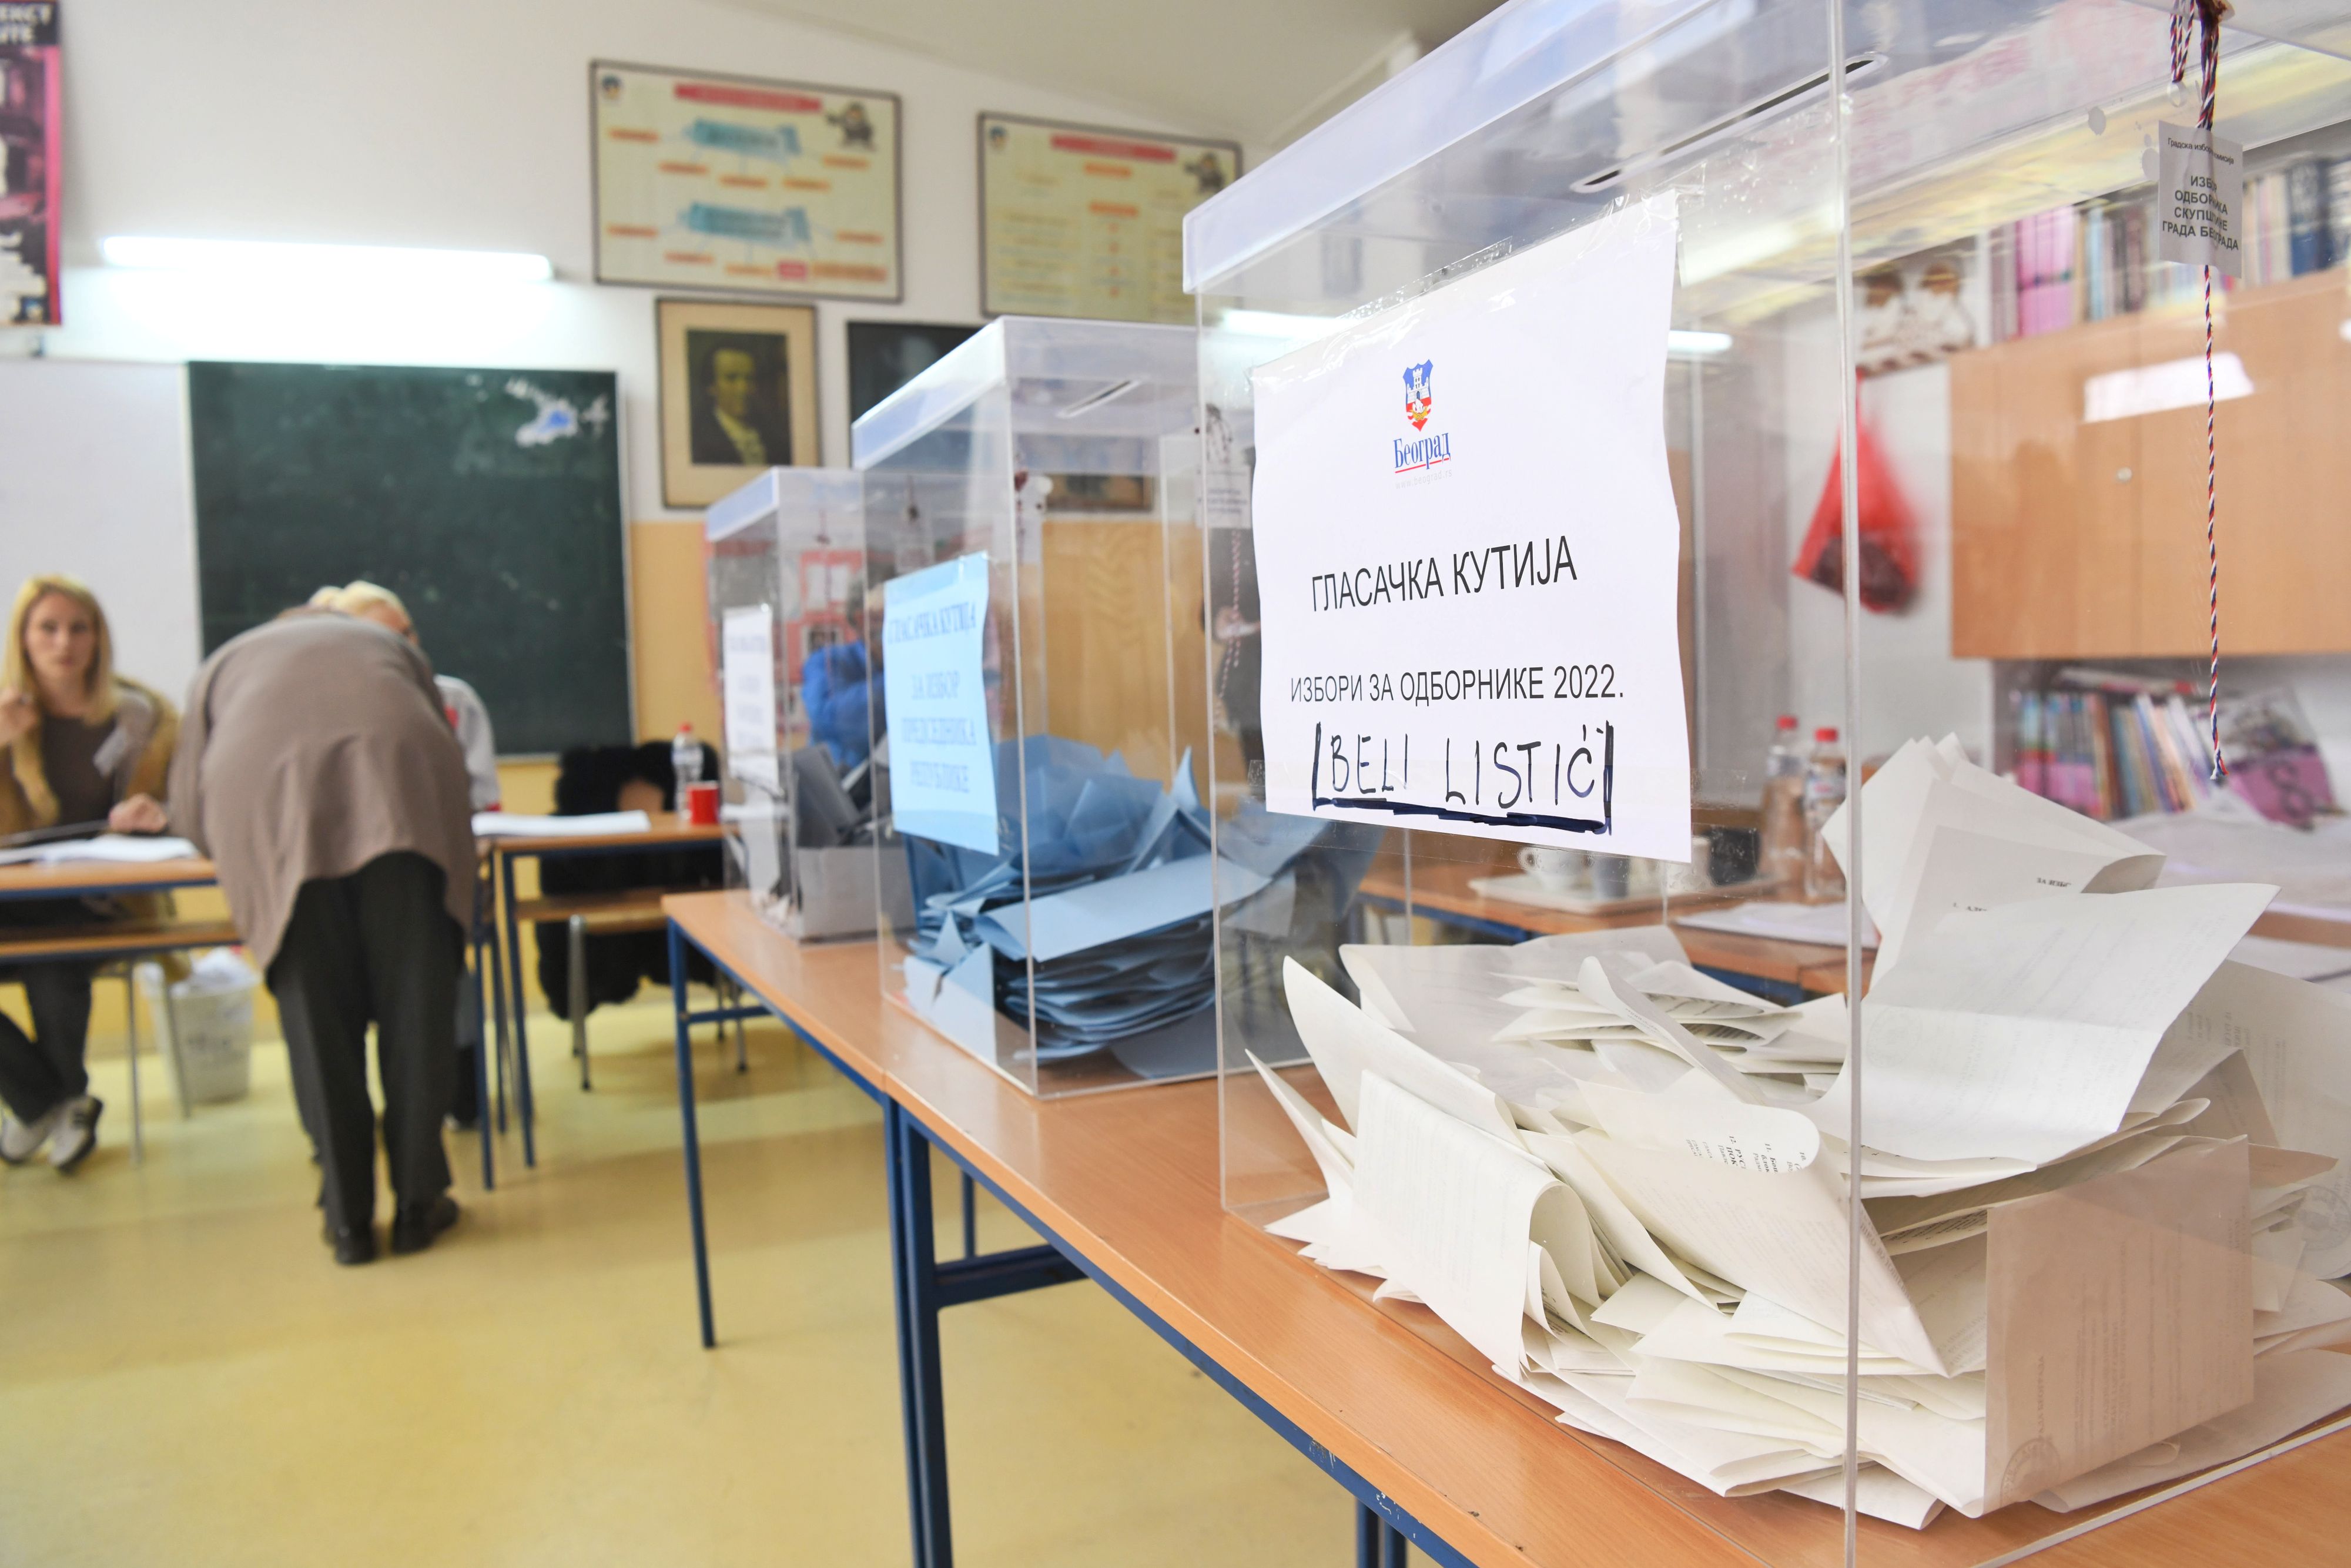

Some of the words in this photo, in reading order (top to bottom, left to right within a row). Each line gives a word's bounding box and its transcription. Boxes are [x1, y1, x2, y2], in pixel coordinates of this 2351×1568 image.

[2168, 138, 2193, 149] Градска
[2162, 220, 2196, 238] ГРАДА
[1393, 433, 1451, 470] Београд
[1395, 469, 1452, 490] www.beograd.rs
[1312, 557, 1444, 612] ГЛАСАЧКА
[1453, 535, 1578, 595] КУТИЈА
[1291, 675, 1362, 702] ИЗБОРИ
[1369, 674, 1394, 701] ЗА
[1401, 666, 1544, 707] ОДБОРНИКЕ
[1554, 664, 1623, 699] 2022.
[1331, 733, 1408, 795] BELI
